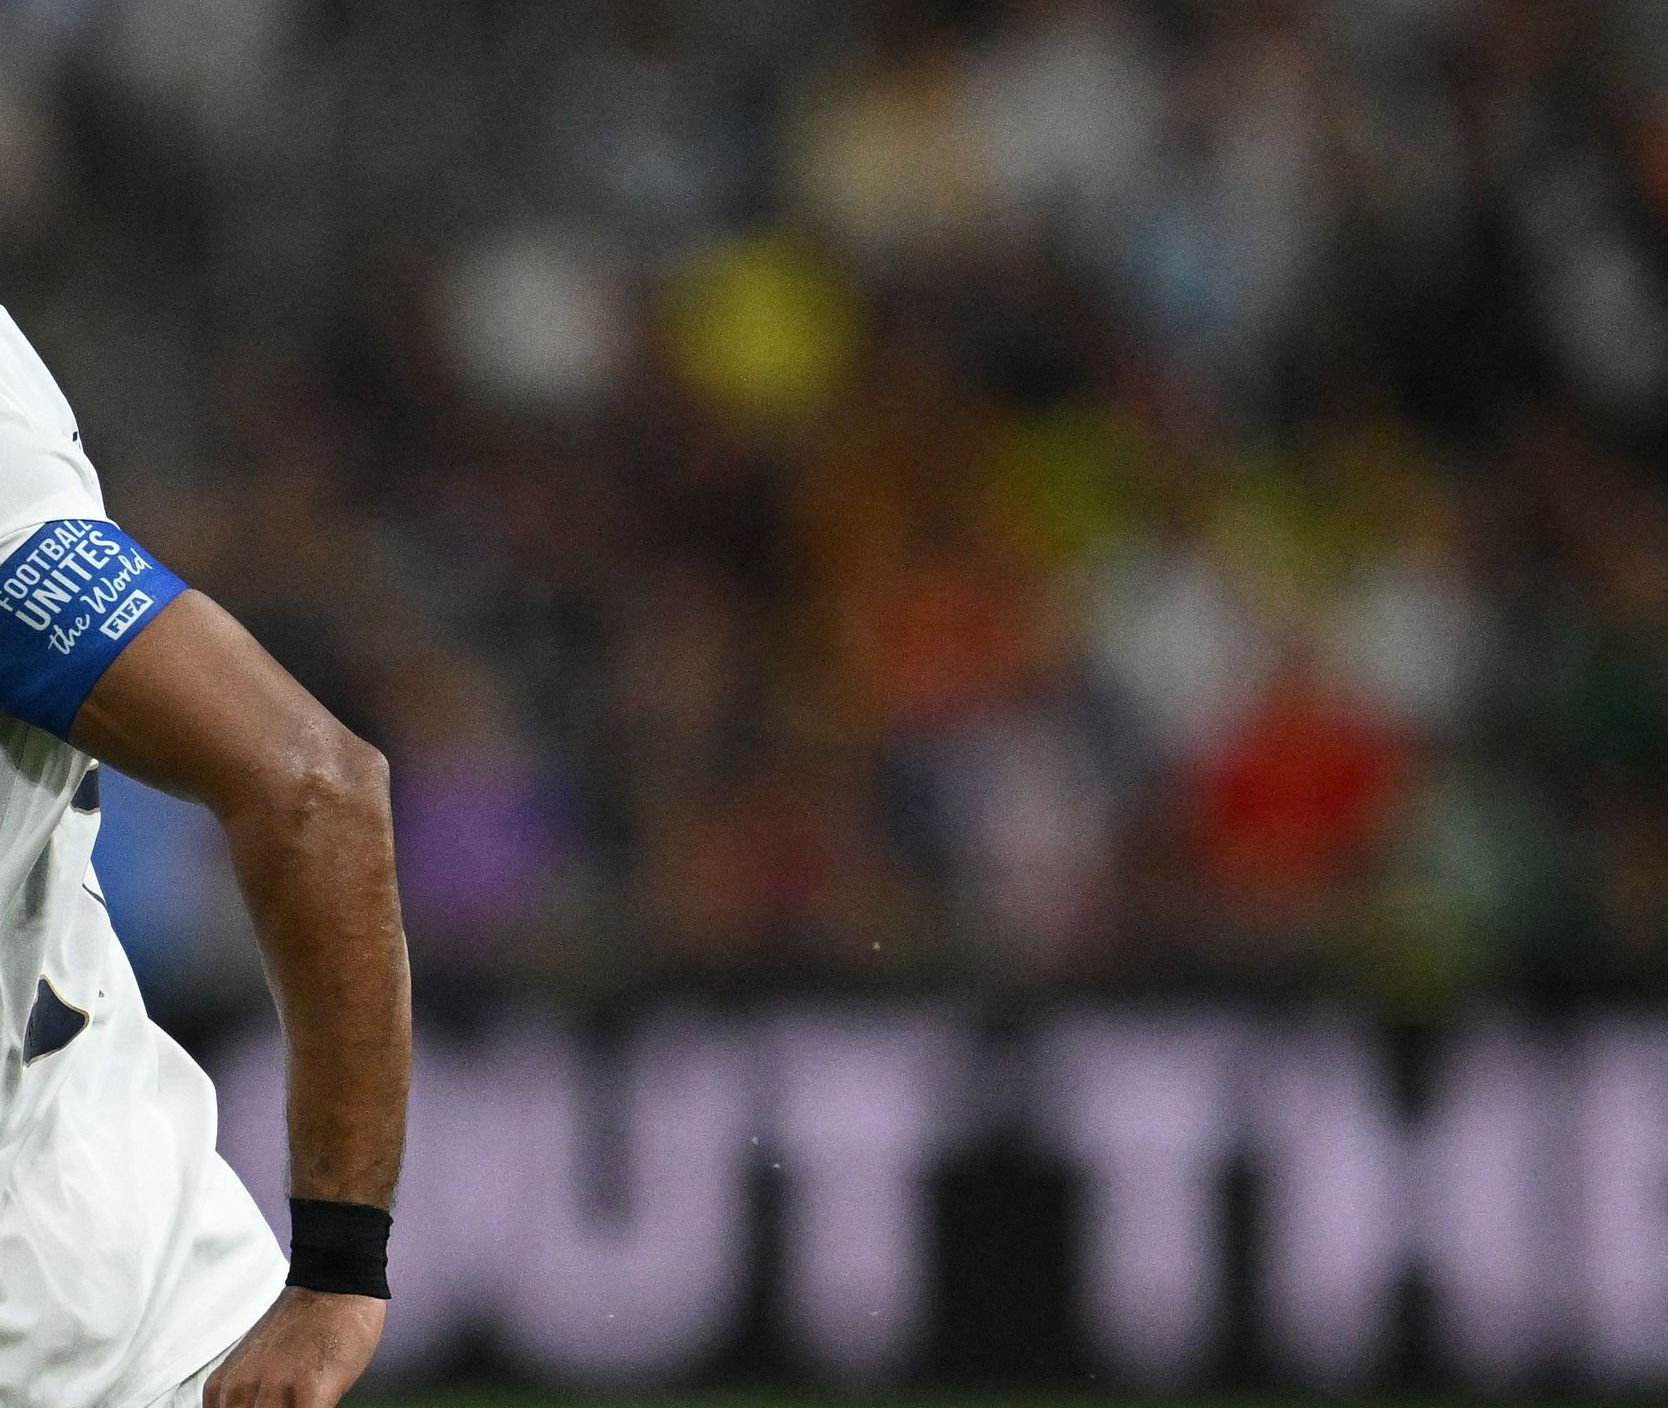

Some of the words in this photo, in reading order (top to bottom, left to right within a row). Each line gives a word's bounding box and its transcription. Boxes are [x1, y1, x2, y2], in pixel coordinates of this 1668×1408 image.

[15, 530, 121, 632] UNITES
[48, 614, 91, 655] the
[80, 547, 153, 614] World
[104, 592, 151, 636] FIFA
